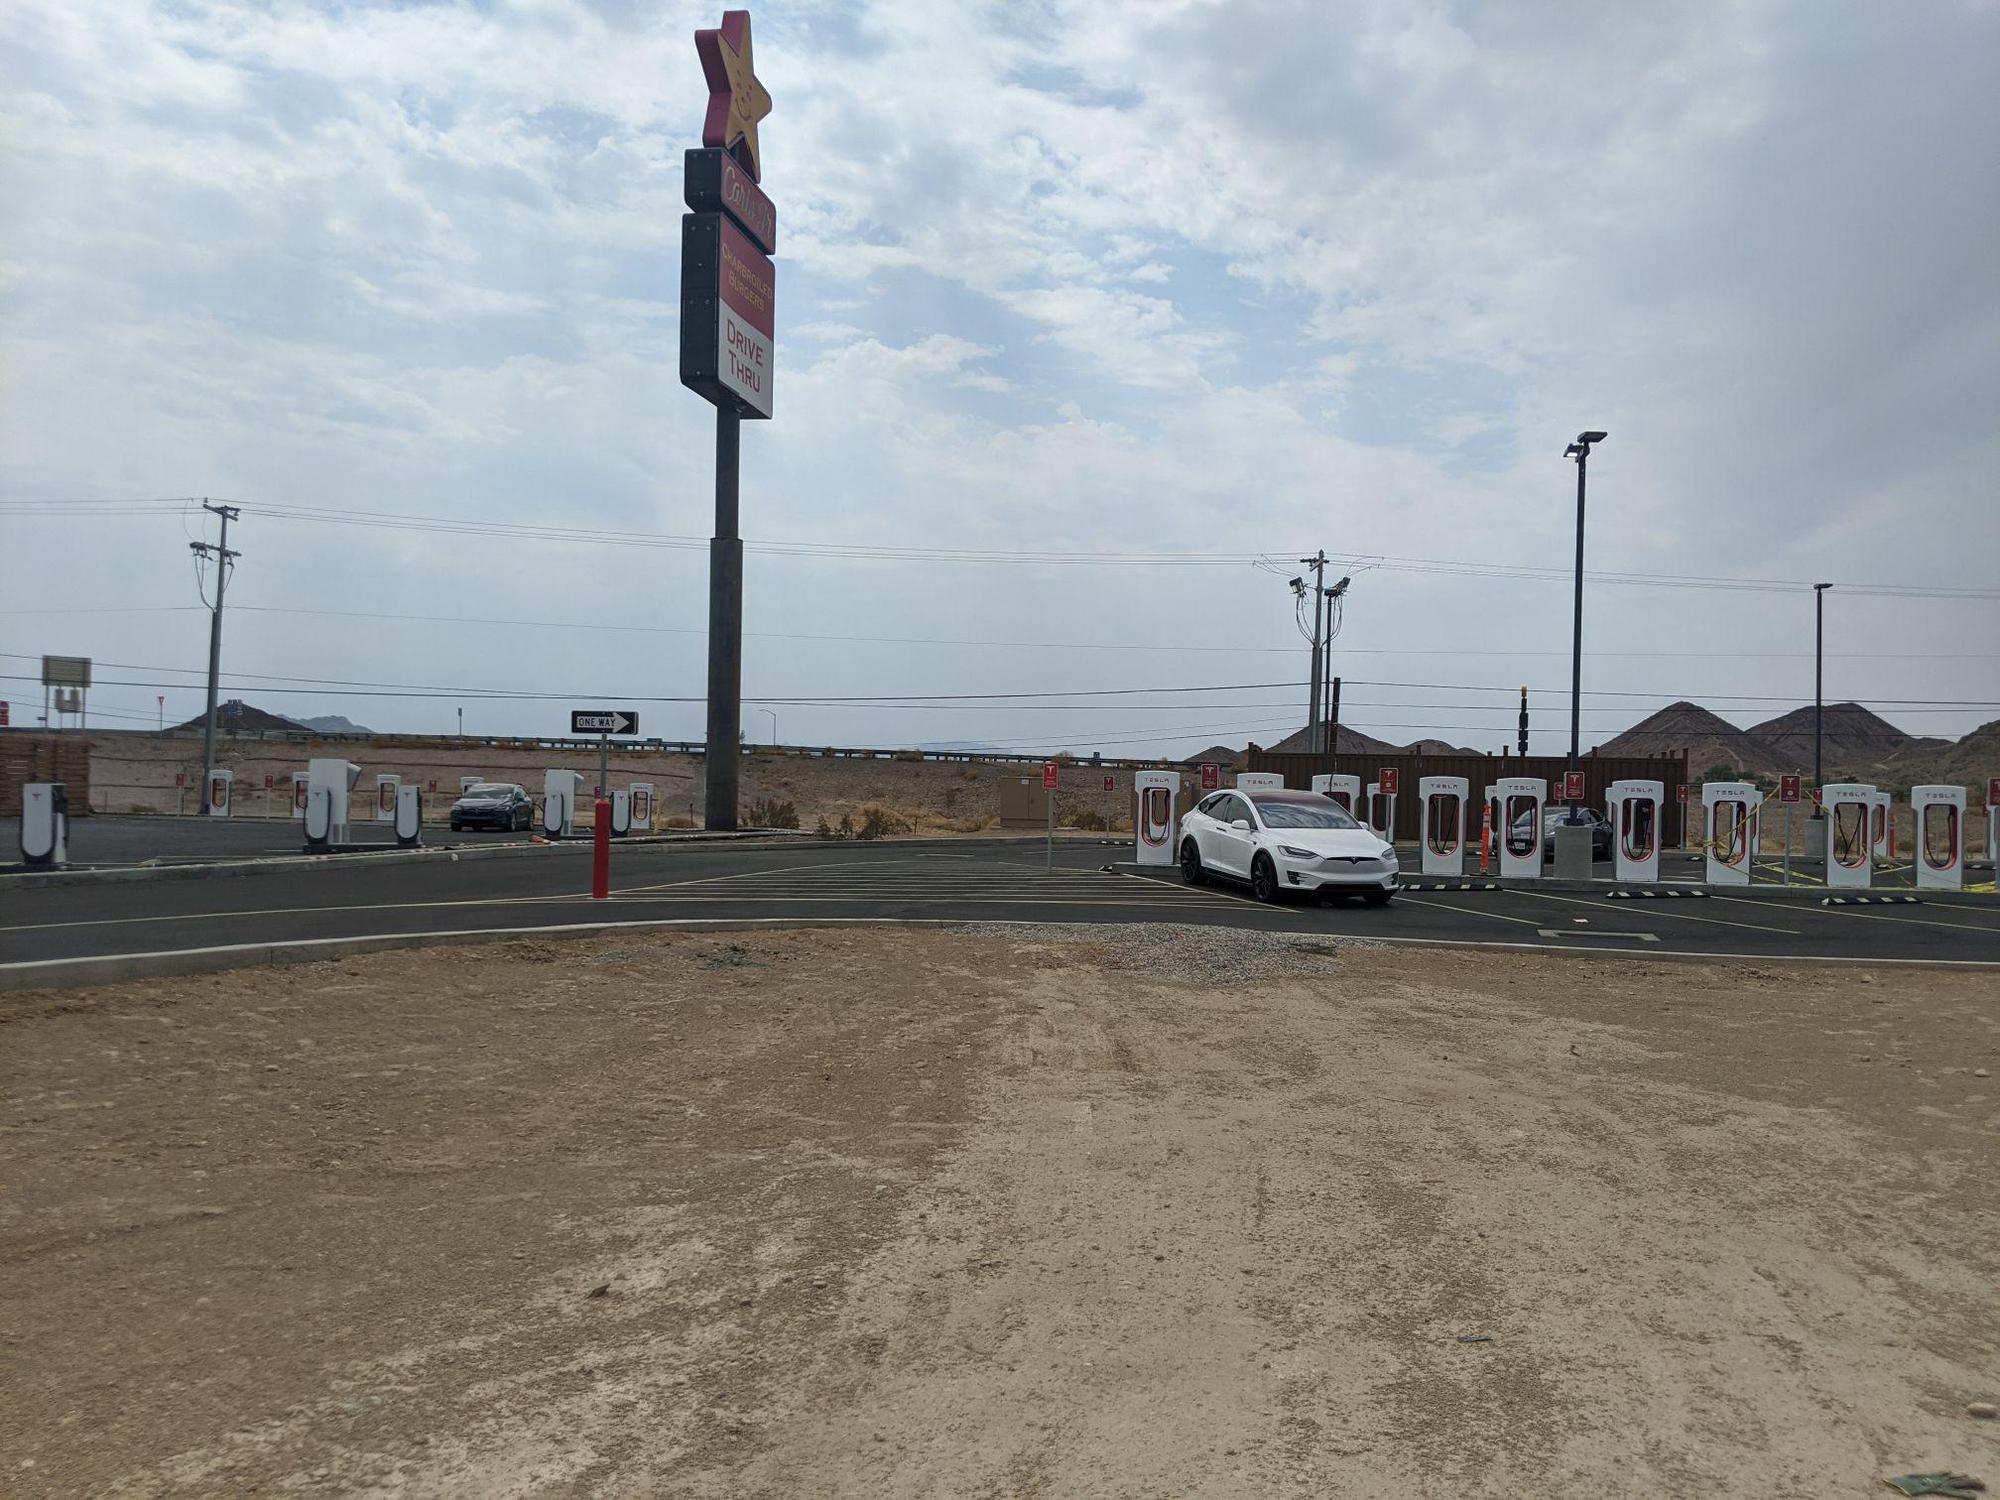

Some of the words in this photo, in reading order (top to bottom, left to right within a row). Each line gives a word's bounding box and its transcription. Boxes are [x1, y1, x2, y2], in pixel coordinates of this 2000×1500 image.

[722, 243, 773, 299] CHARBROILED
[728, 271, 765, 311] BURGERS
[727, 318, 763, 367] DRIVE
[728, 349, 761, 392] THRU
[578, 717, 596, 727] ONE
[598, 717, 616, 727] WAY
